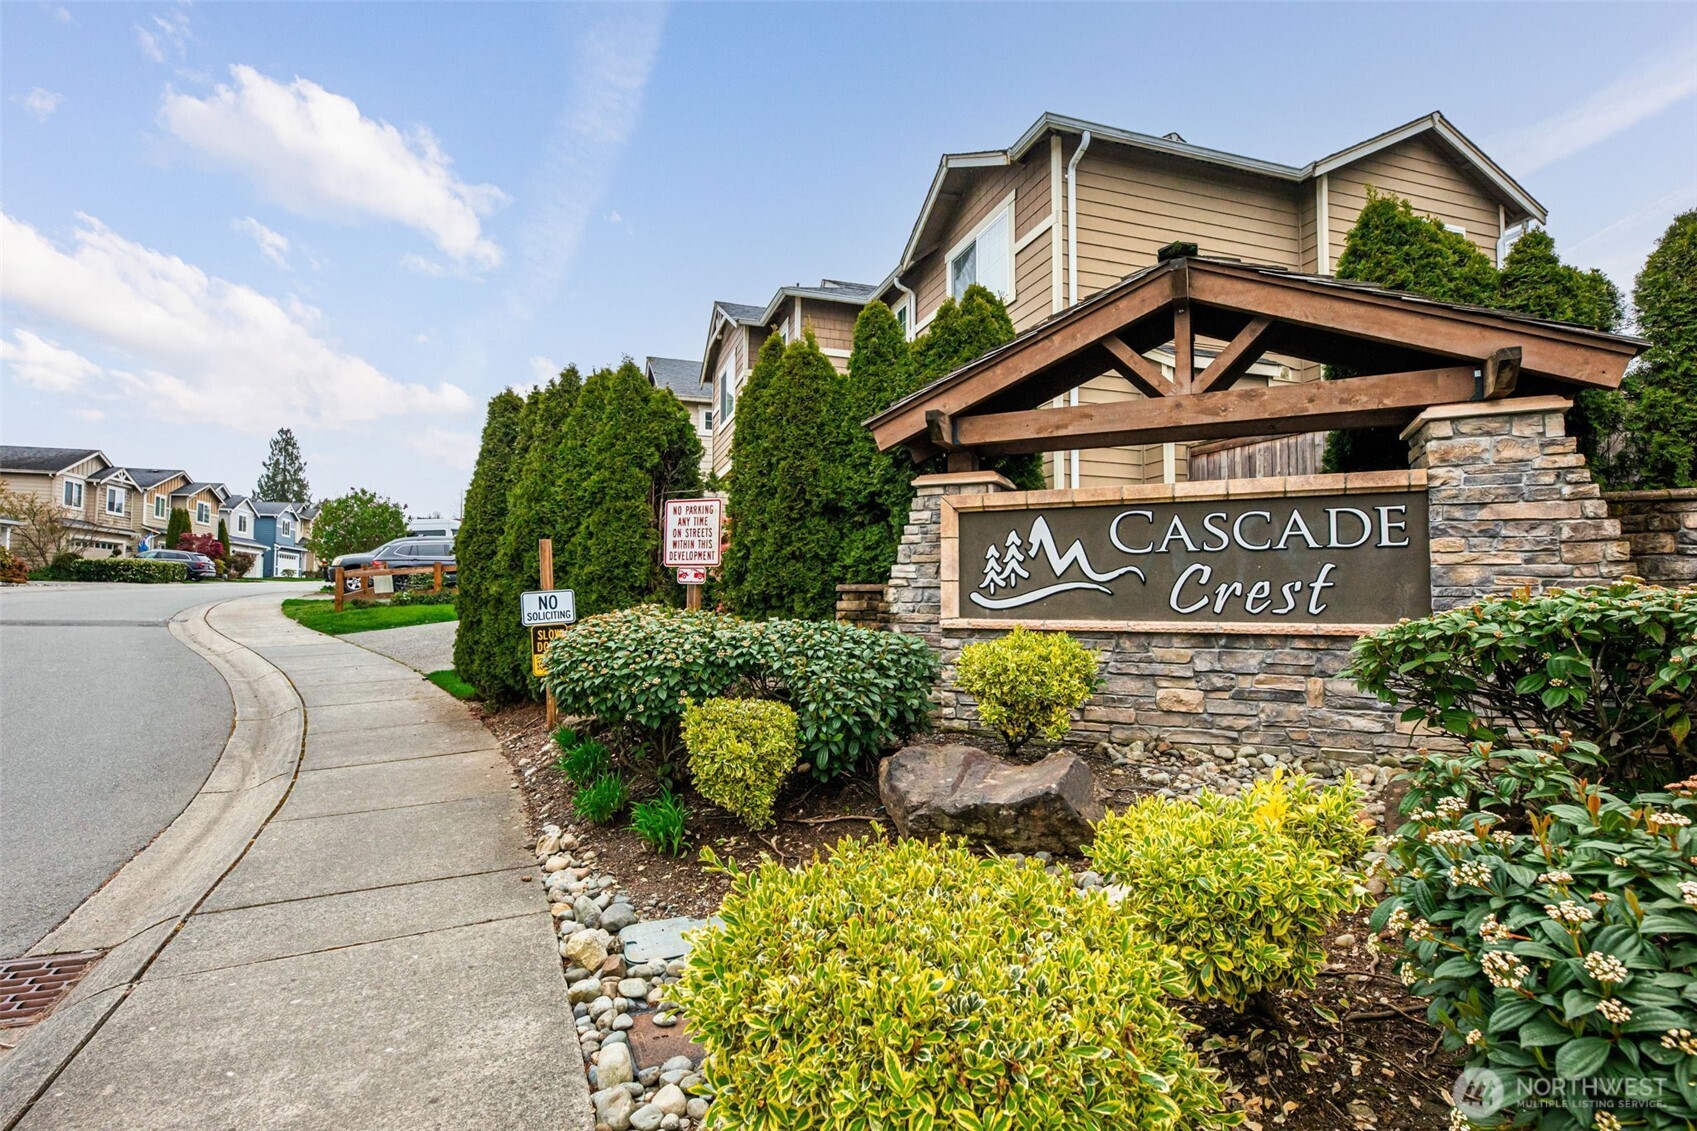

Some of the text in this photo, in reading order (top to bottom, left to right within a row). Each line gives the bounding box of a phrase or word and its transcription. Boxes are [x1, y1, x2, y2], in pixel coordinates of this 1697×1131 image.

[672, 504, 714, 515] NO PARKING
[677, 516, 708, 526] ANY TIME
[672, 527, 713, 538] ON STREETS
[1108, 504, 1410, 554] CASCADE
[672, 539, 713, 549] WITHIN THIS
[669, 550, 715, 561] DEVELOPMENT
[1168, 562, 1338, 616] Crest
[538, 594, 558, 611] NO
[526, 609, 571, 622] SOLICITING
